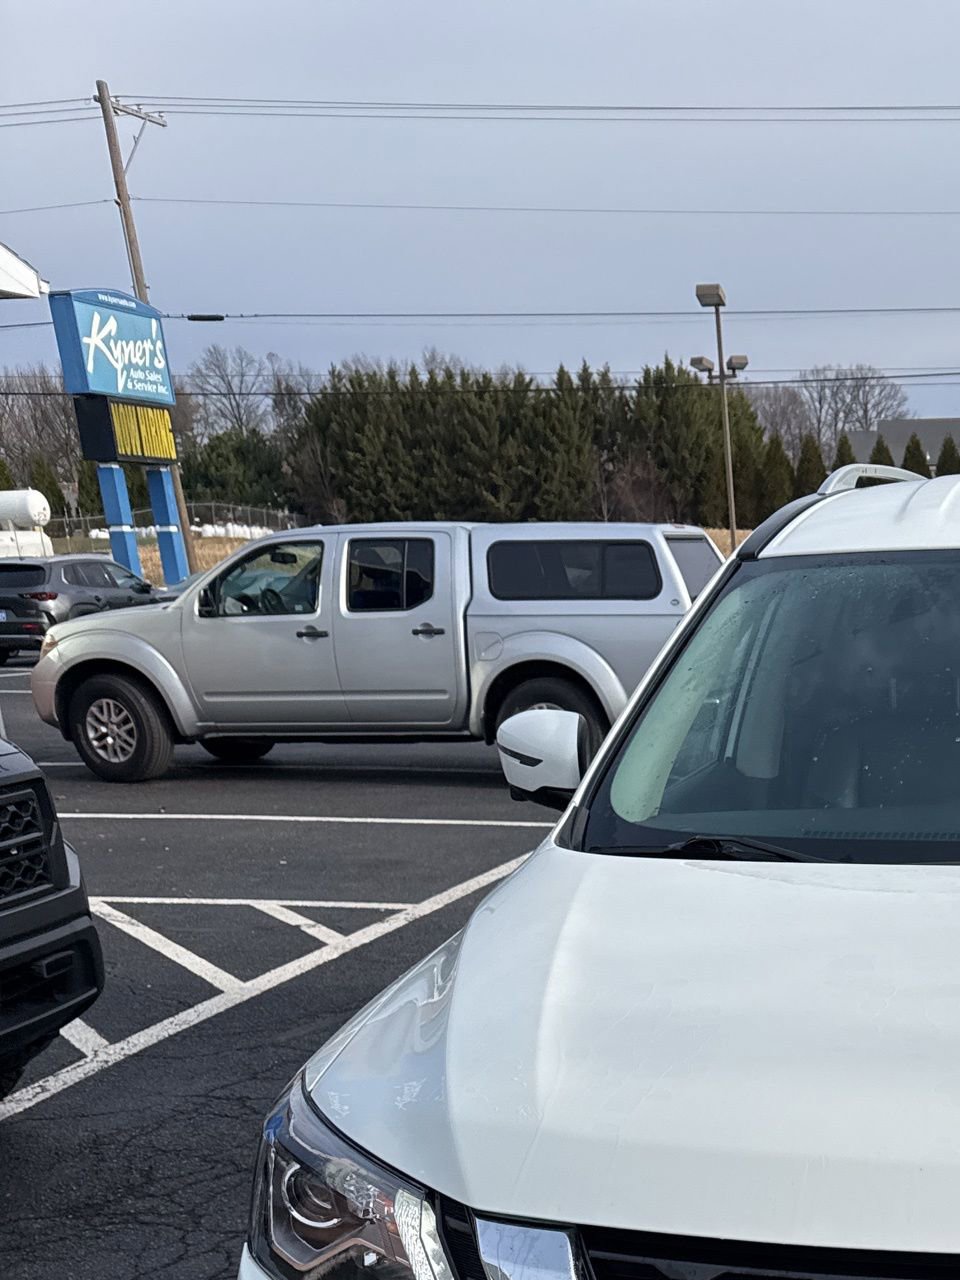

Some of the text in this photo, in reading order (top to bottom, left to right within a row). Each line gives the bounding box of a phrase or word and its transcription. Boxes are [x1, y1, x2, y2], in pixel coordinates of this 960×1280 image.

[82, 311, 165, 393] Kyner's
[127, 379, 133, 389] &
[134, 380, 157, 392] Service
[129, 367, 162, 382] Auto Sales
[110, 402, 177, 460] NOW HIRING
